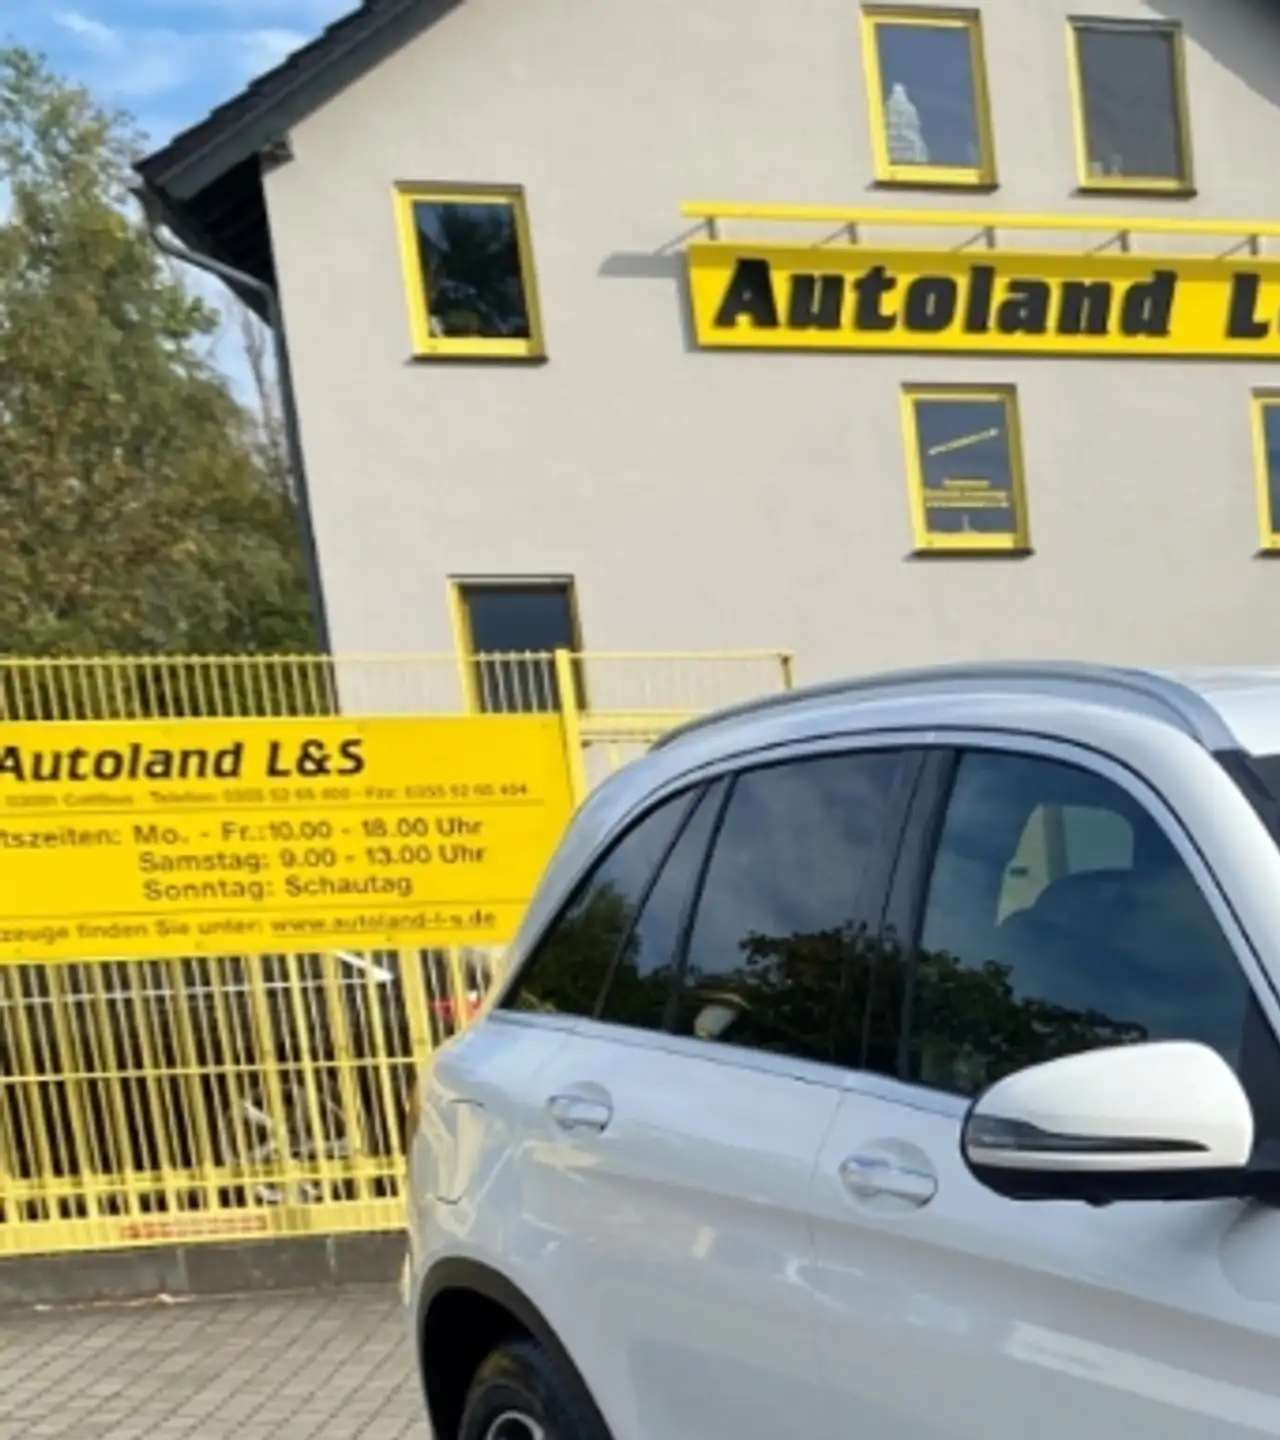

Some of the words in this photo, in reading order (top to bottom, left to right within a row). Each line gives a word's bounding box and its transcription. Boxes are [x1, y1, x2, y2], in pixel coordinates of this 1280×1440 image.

[714, 258, 1177, 337] Autoland
[0, 741, 244, 782] Autoland
[265, 738, 365, 777] L&S
[133, 824, 189, 845] Mo.
[436, 816, 484, 837] Uhr
[139, 850, 270, 874] Samstag:
[439, 844, 486, 864] Uhr
[143, 879, 273, 902] Sonntag:
[286, 875, 412, 898] Schautag
